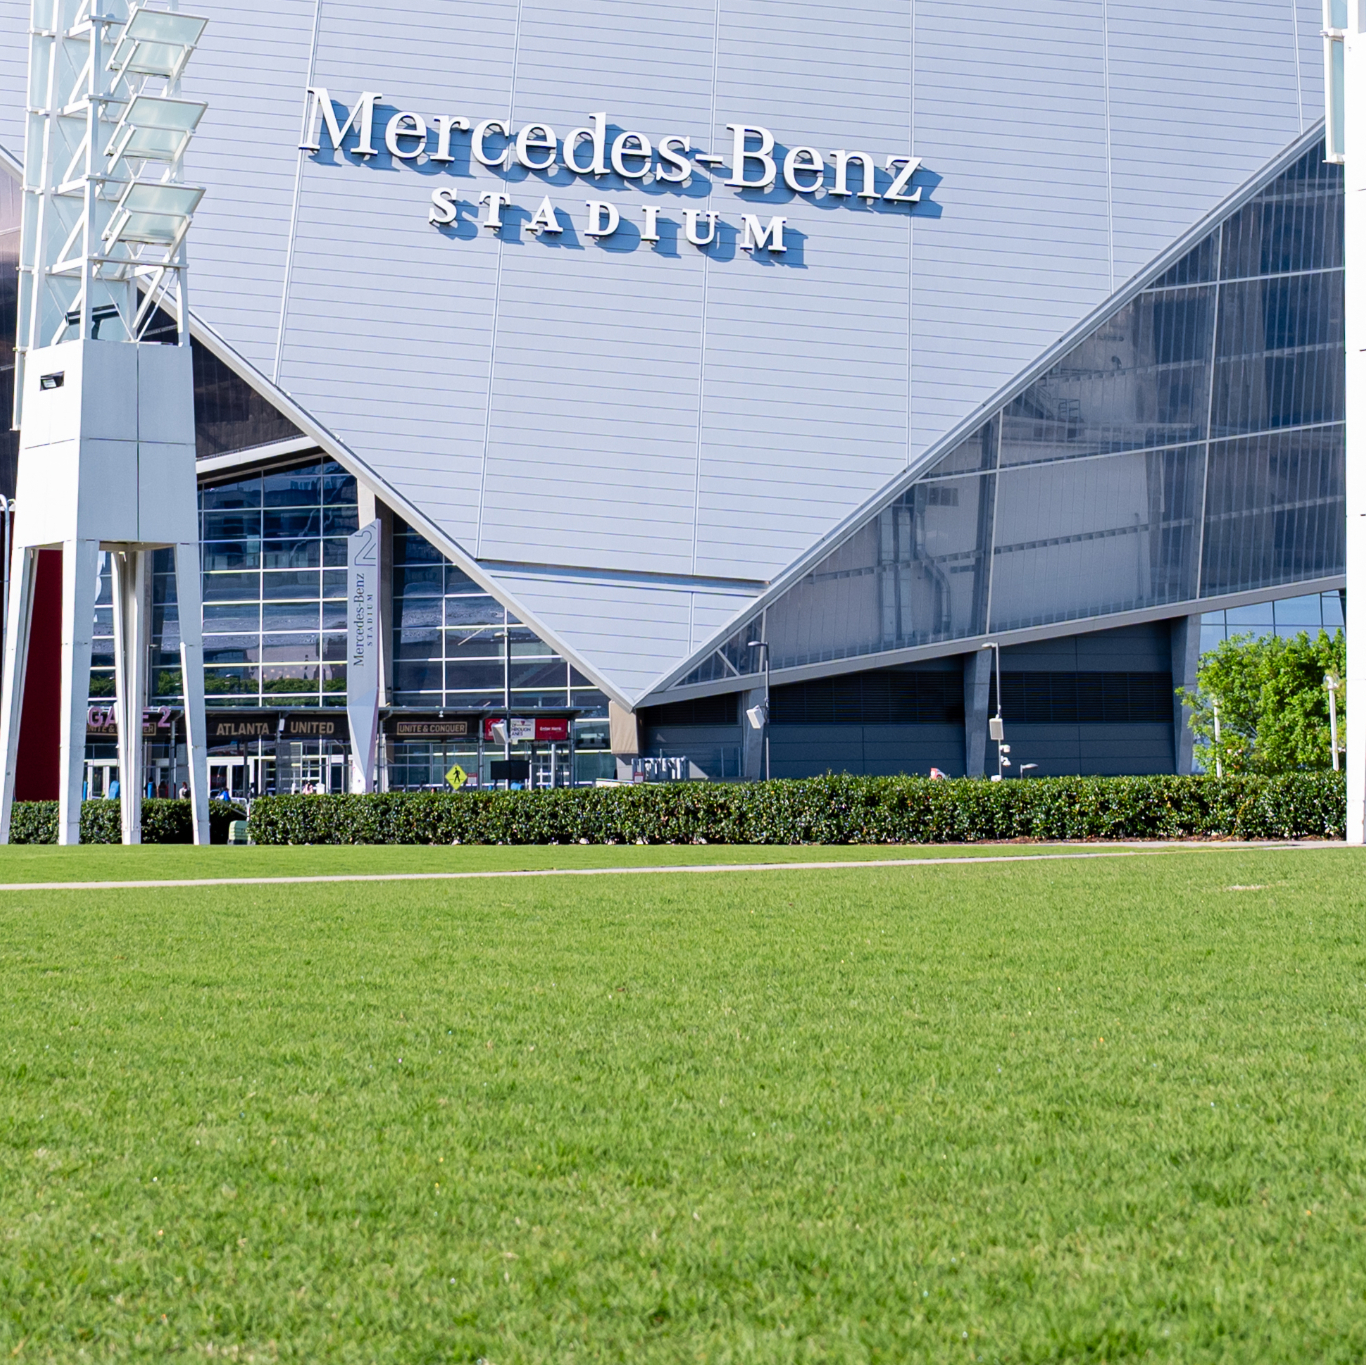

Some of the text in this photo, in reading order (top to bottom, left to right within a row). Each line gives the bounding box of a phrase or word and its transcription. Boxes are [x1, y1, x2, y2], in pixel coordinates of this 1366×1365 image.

[298, 87, 923, 203] Mercedes-Benz
[428, 188, 788, 252] STADIUM
[353, 573, 365, 667] Mercedes-Benz
[88, 705, 171, 728] GAE 2
[290, 721, 335, 734] UNITED
[216, 722, 270, 736] ATLANTA
[399, 724, 465, 733] UNITE & CONQUER
